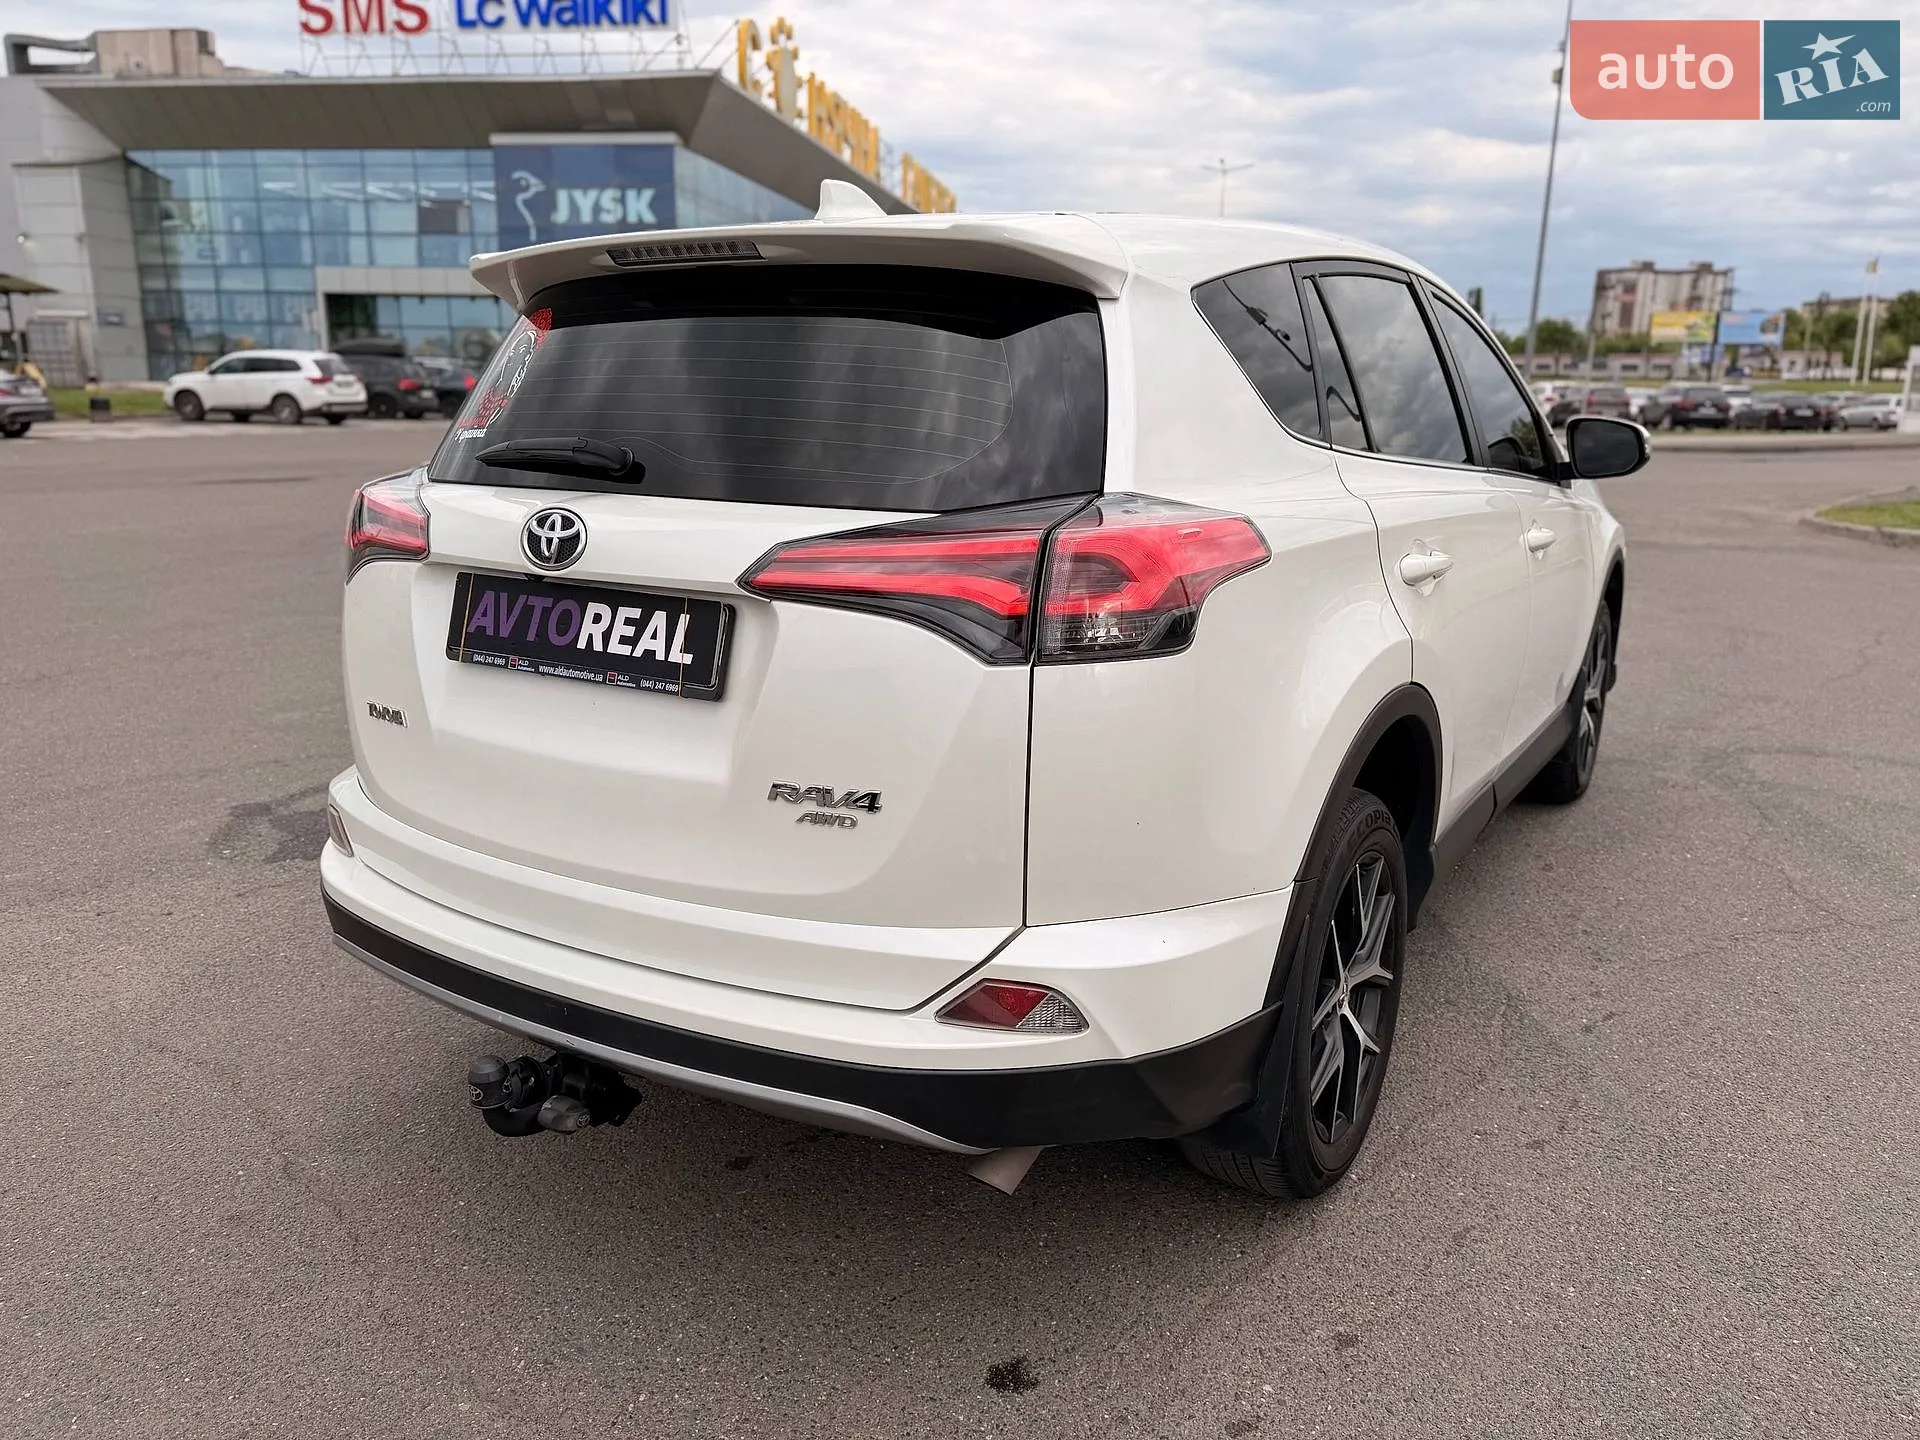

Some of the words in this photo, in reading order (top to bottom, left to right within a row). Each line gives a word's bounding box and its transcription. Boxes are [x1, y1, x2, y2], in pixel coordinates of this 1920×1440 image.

[550, 188, 658, 224] JYSK
[467, 590, 694, 665] AVTOREAL
[538, 664, 603, 682] www.aldautomotive.ua
[640, 679, 655, 690] (044)
[654, 681, 665, 690] 247
[665, 683, 679, 692] 6969
[767, 780, 882, 815] RAV4
[796, 810, 858, 829] AWD
